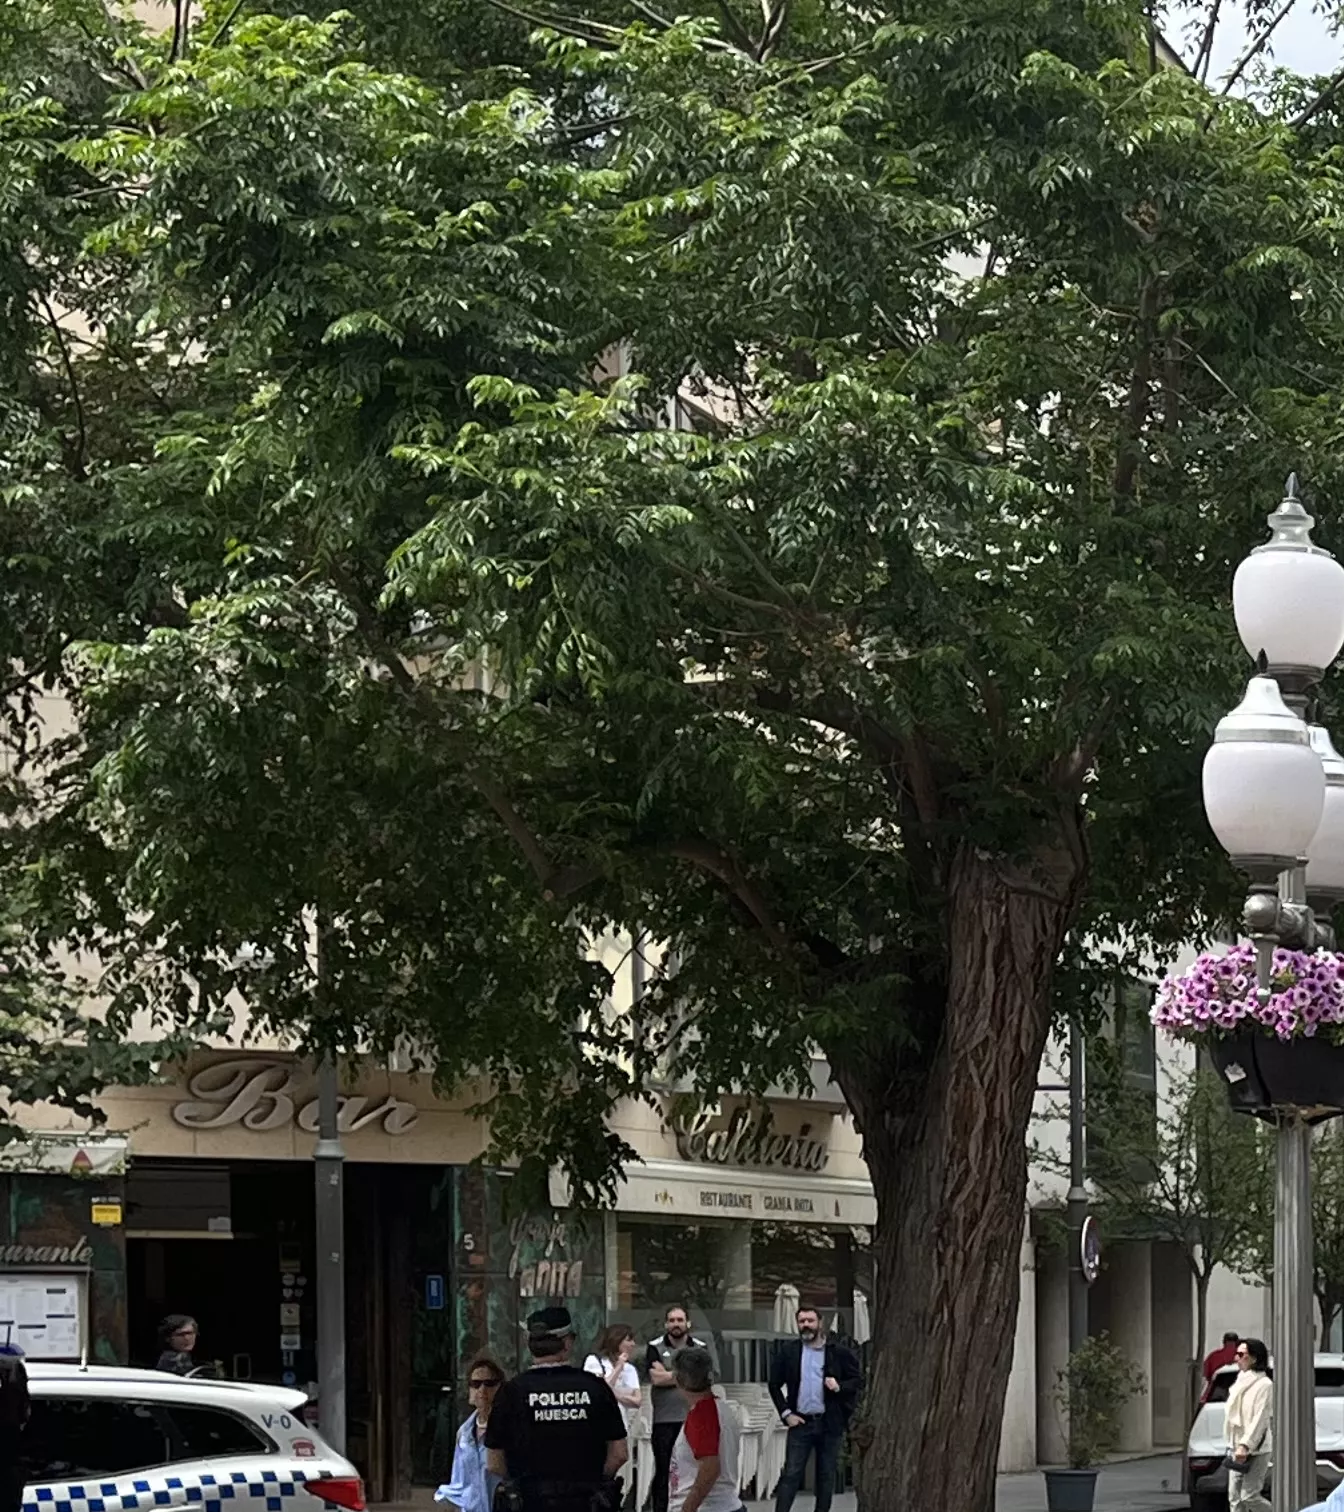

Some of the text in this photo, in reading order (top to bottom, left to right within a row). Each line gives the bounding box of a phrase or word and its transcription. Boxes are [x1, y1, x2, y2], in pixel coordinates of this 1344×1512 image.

[173, 1058, 418, 1134] Bar
[463, 1233, 476, 1251] 5
[528, 1391, 592, 1407] POLICIA
[534, 1408, 588, 1422] HUESCA
